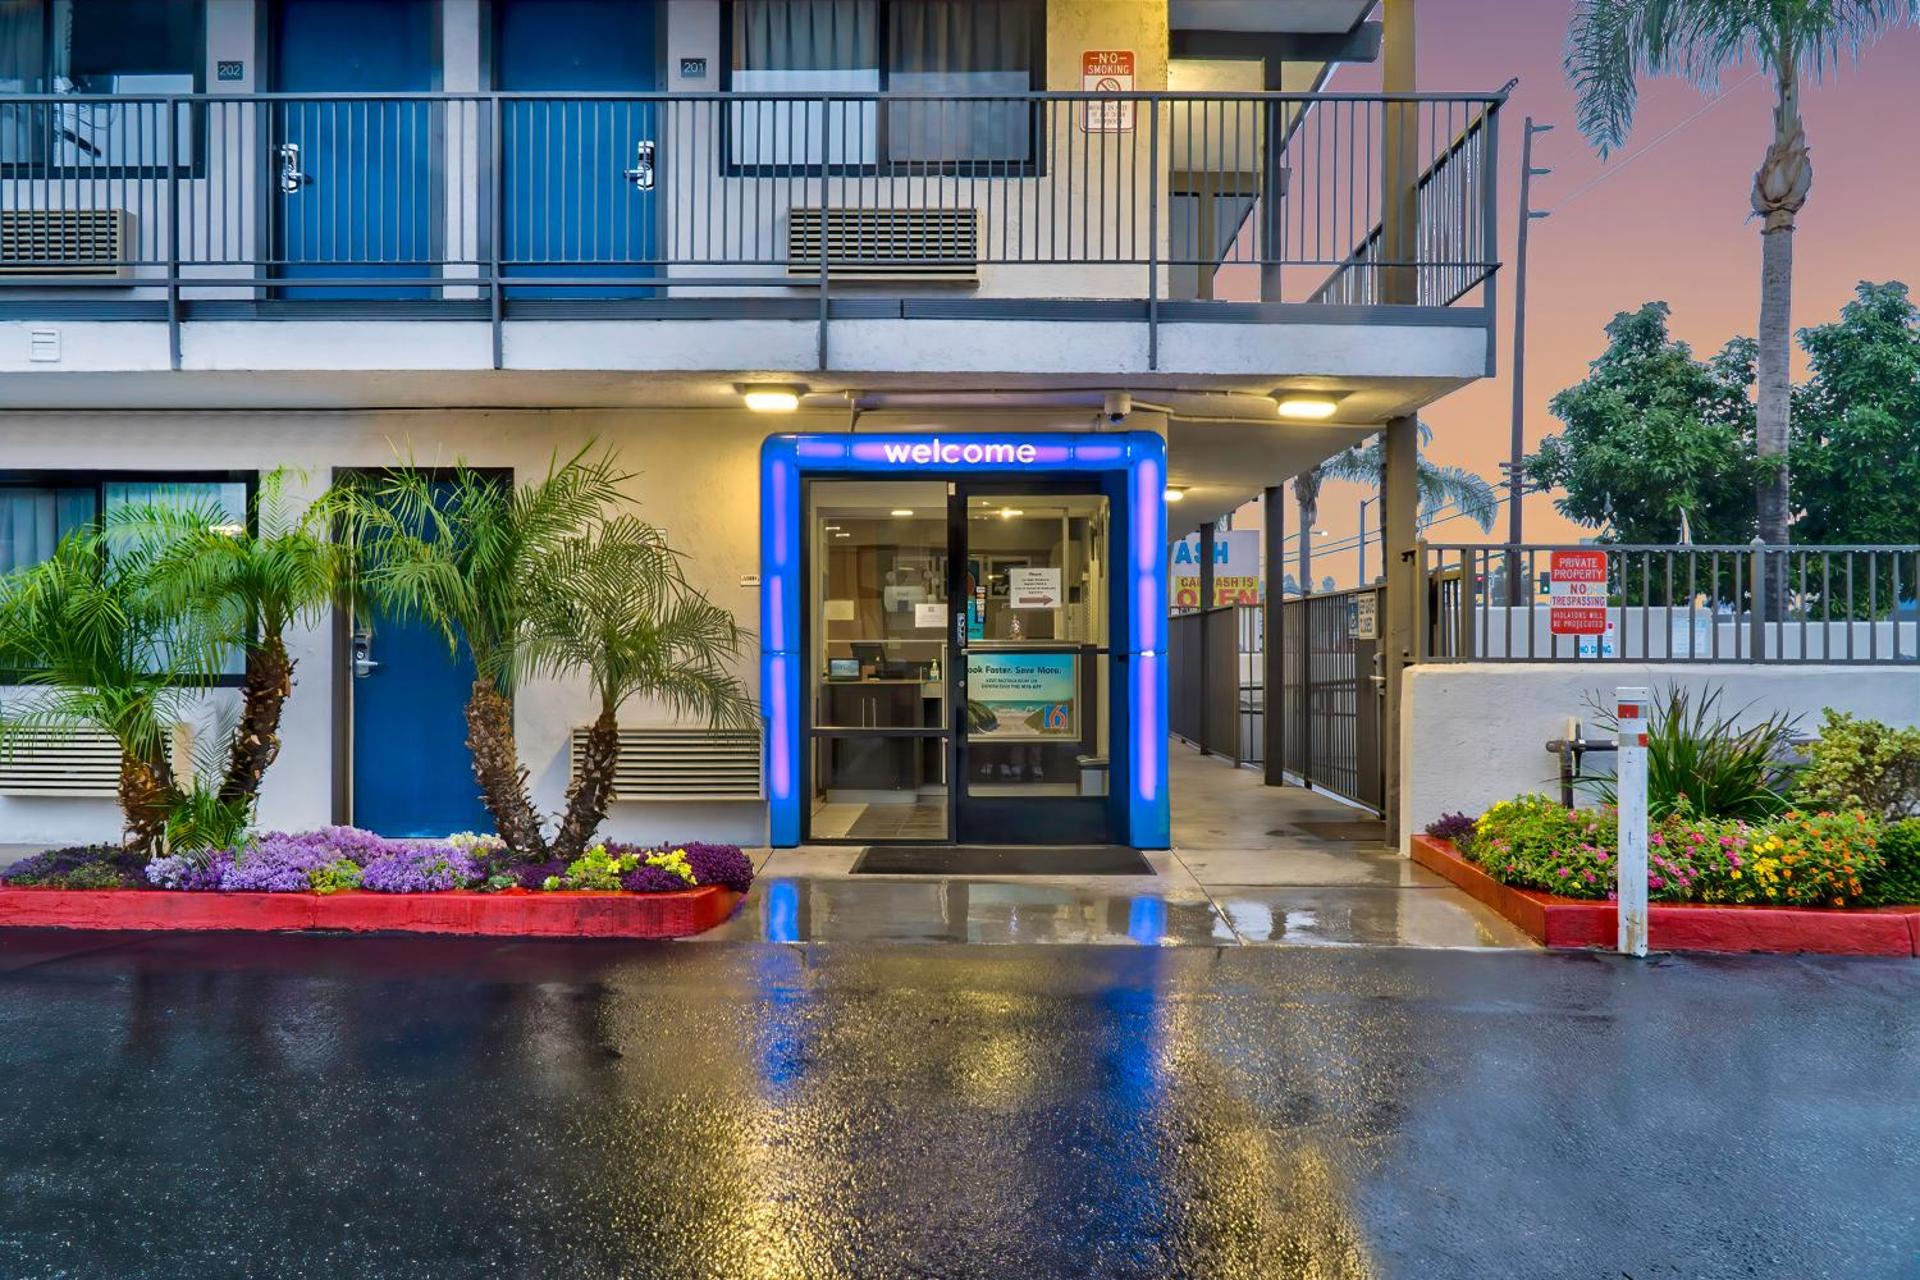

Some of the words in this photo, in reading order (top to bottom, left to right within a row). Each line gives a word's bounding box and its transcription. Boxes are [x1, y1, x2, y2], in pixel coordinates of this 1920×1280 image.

[1099, 52, 1118, 64] NO
[220, 64, 240, 76] 202
[684, 62, 704, 73] 201
[1087, 64, 1130, 74] SMOKING
[883, 438, 1037, 464] welcome
[1174, 541, 1228, 564] ASH
[1559, 557, 1599, 568] PRIVATE
[1553, 568, 1604, 580] PROPERTY
[1569, 583, 1587, 595] NO
[1177, 588, 1258, 607] OEN
[1552, 595, 1606, 607] TRESPASSING
[967, 664, 982, 674] ook
[1015, 666, 1034, 674] Save
